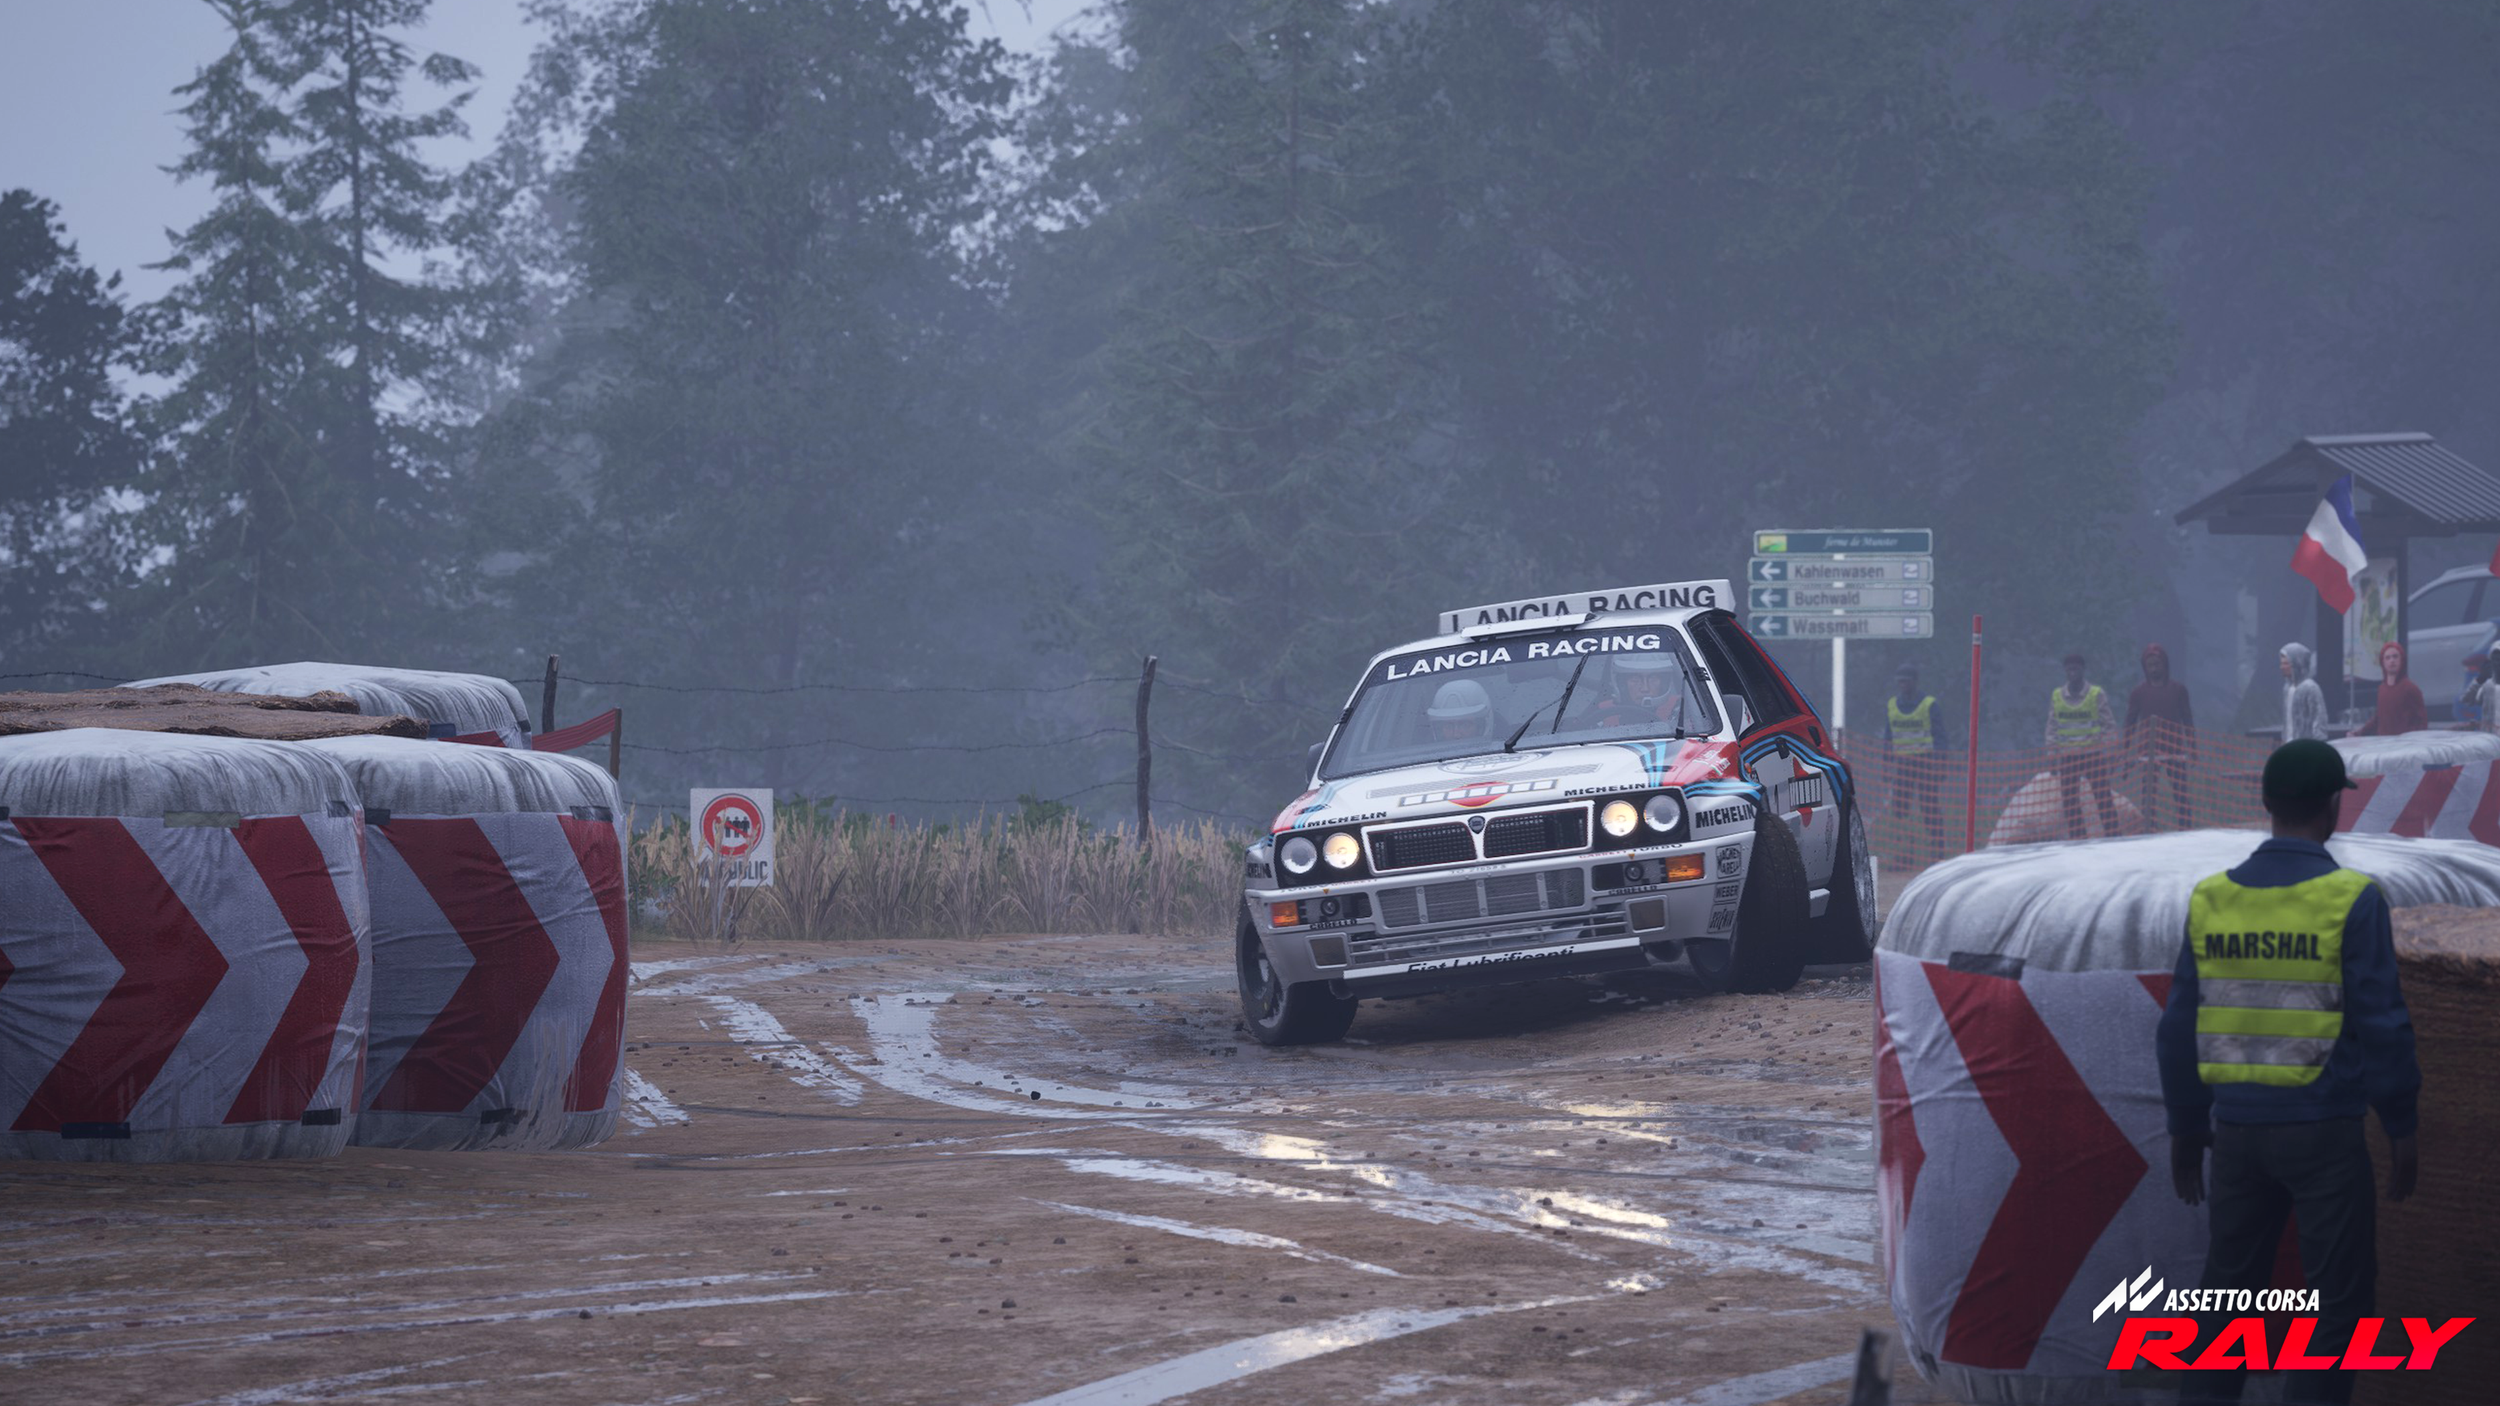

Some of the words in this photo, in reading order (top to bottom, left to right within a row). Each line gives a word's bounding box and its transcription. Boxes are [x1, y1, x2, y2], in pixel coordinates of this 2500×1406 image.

[1794, 564, 1885, 578] Kahlenwasen
[1589, 585, 1716, 613] RACING
[1794, 591, 1861, 605] Buchwald
[1793, 618, 1869, 633] Wassmatt
[1387, 647, 1511, 681] LANCIA
[1528, 634, 1661, 659] RACING
[1564, 782, 1646, 796] MICHELIN
[1307, 811, 1387, 828] MICHELIN
[1695, 804, 1756, 828] MICHELIN
[2205, 931, 2322, 961] MARSHAL
